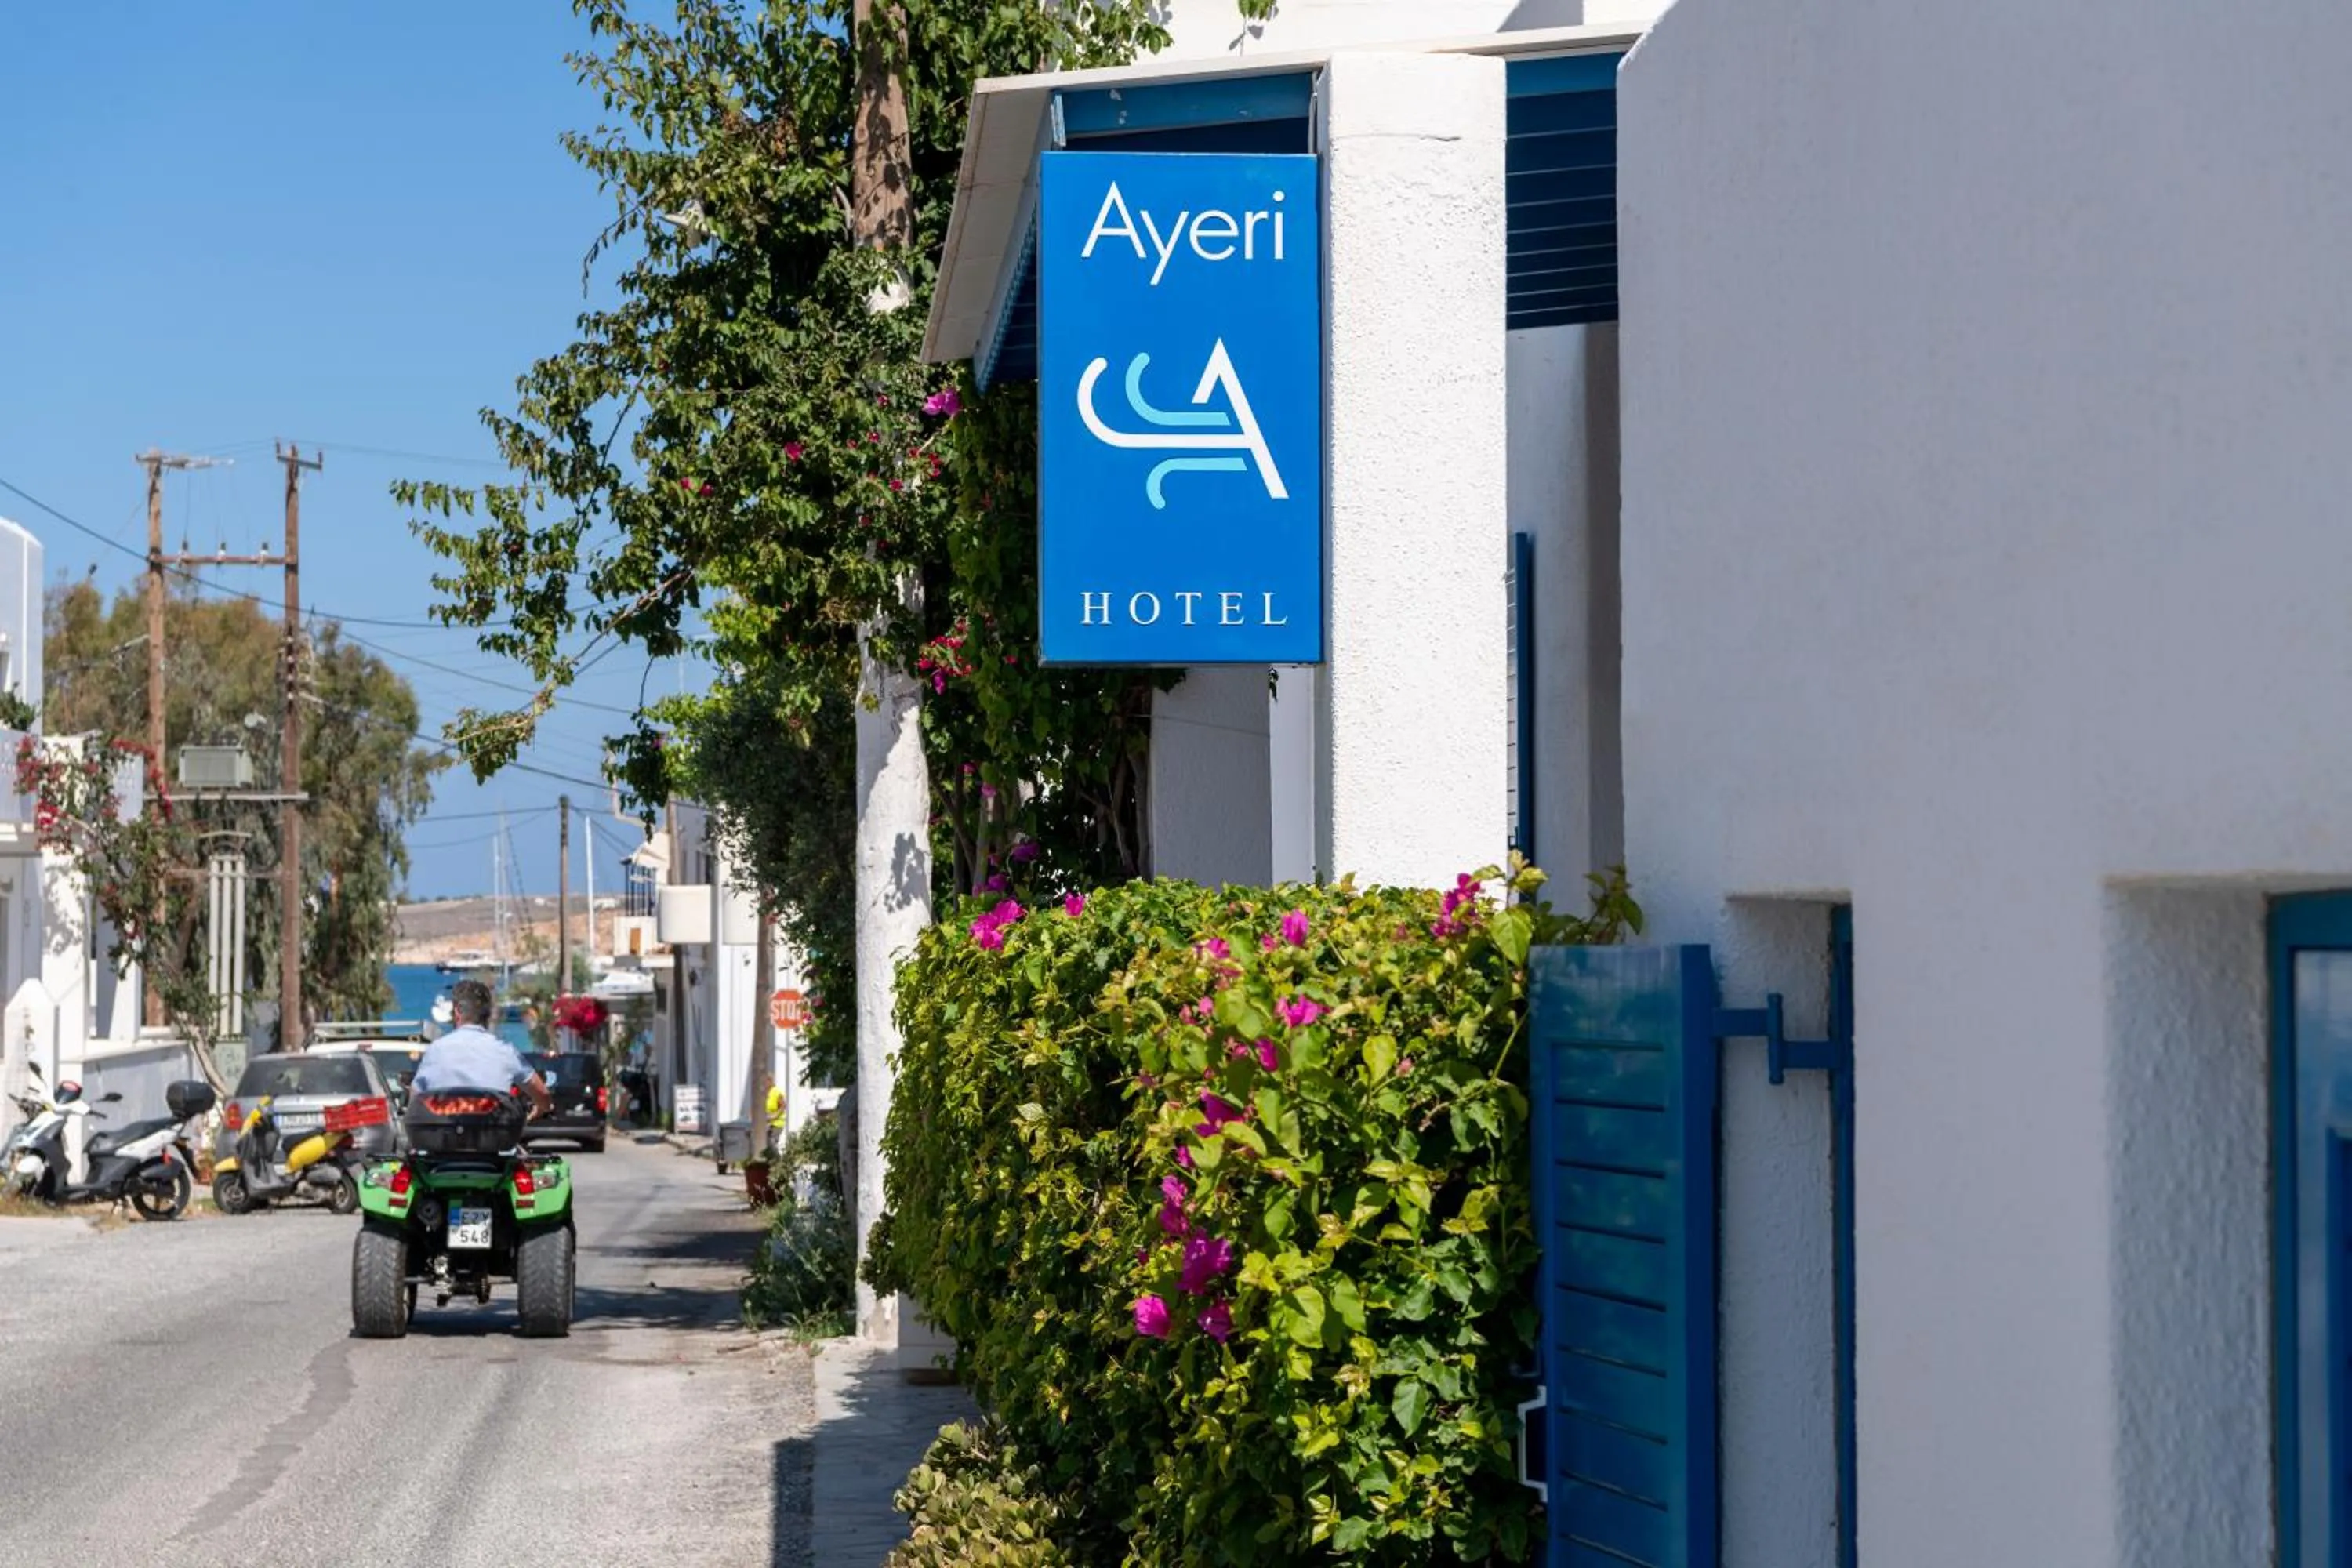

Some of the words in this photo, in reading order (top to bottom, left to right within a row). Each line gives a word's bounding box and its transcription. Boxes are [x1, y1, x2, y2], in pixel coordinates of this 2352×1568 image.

[1081, 181, 1286, 286] Ayeri
[1080, 590, 1288, 626] HOTEL
[460, 1229, 489, 1244] 548
